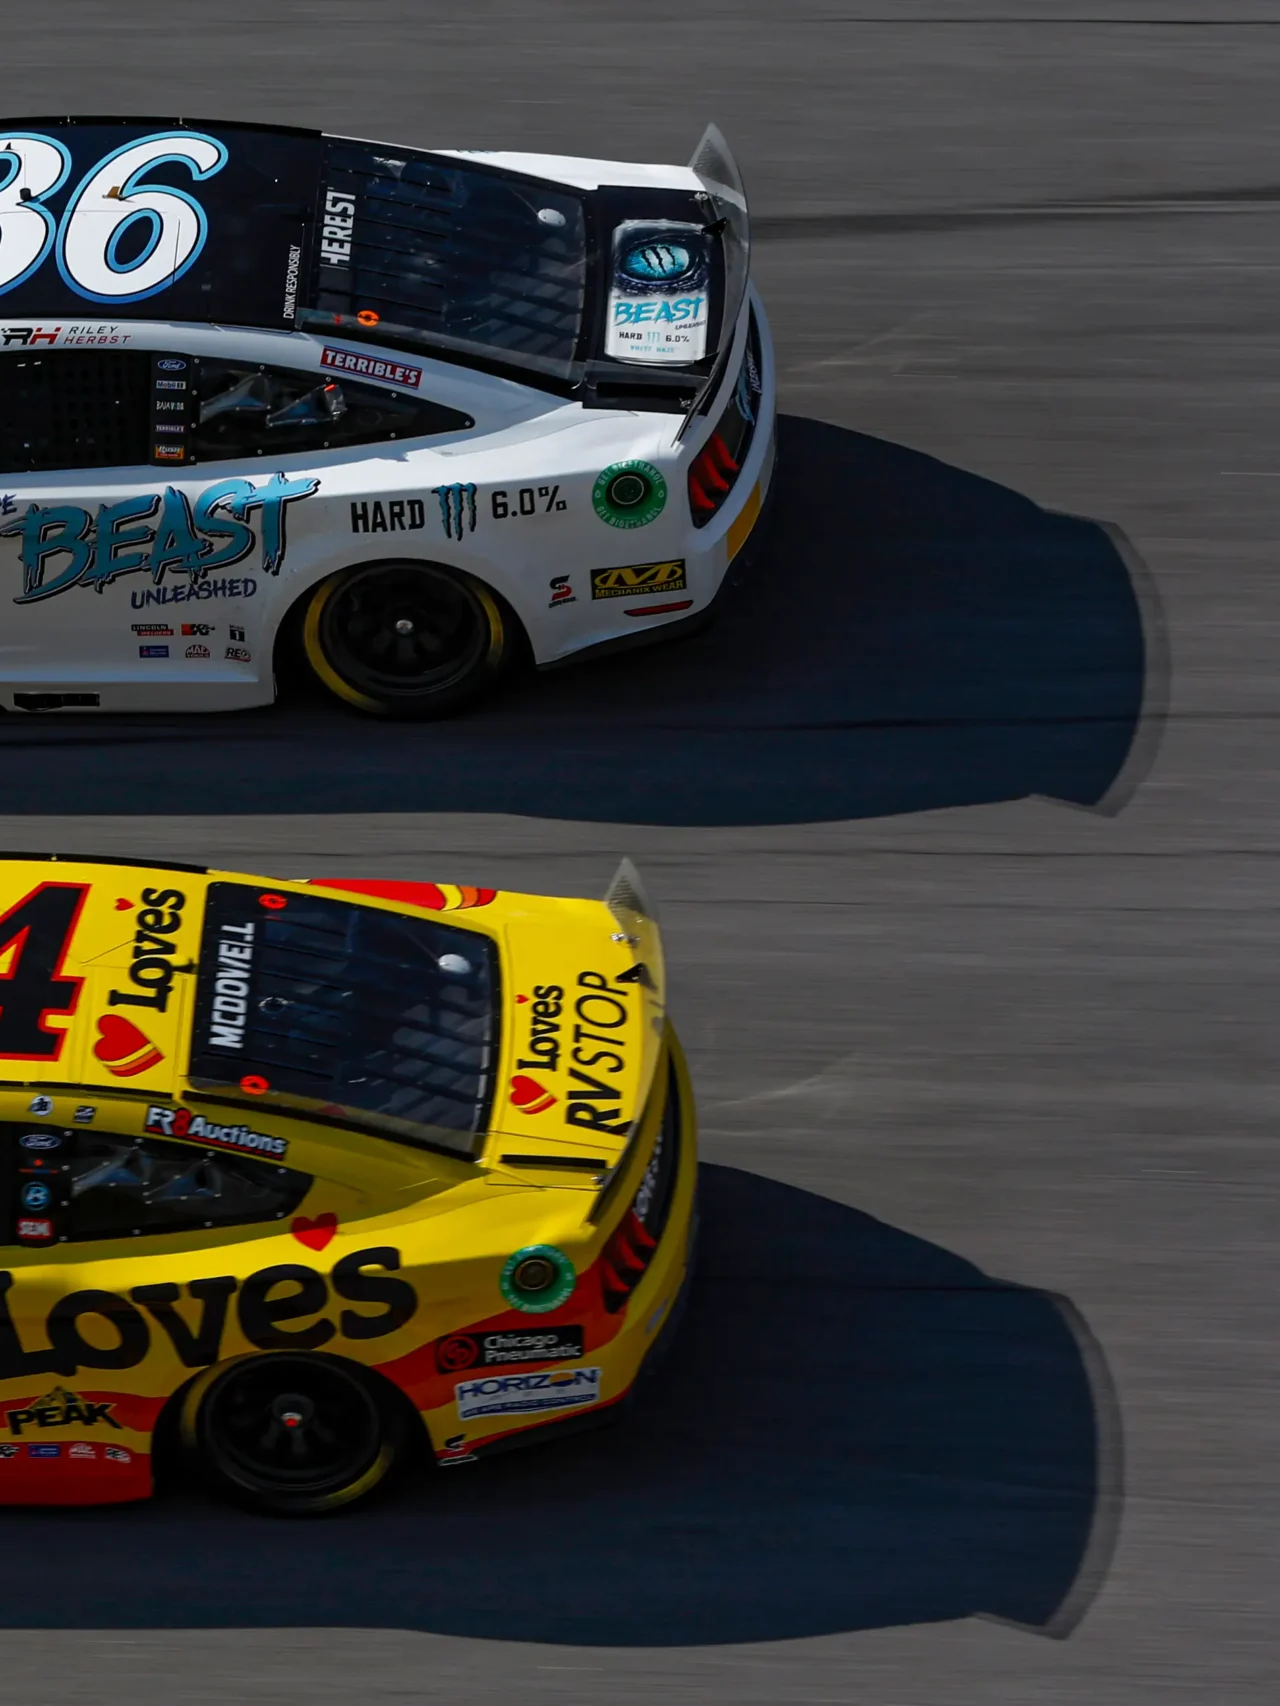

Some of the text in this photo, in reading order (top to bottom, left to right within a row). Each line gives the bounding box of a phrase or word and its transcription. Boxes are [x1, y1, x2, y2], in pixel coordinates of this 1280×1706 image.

[283, 245, 301, 319] DRINK RESPONSIBLY
[614, 297, 704, 326] BEAST
[63, 335, 132, 345] HERBST
[68, 325, 119, 335] RILEY
[619, 331, 690, 343] HARD 6.0%
[160, 360, 183, 370] Ford
[326, 350, 419, 385] TERRIBLE'S
[350, 485, 567, 533] HARD 6.0%
[130, 578, 257, 610] UNLEASHED
[595, 579, 684, 598] MECHANIX WEAR
[208, 922, 255, 1049] MCDOWELL
[484, 1333, 559, 1349] Chicago
[484, 1344, 582, 1363] Pneumatic
[7, 1402, 123, 1435] PEAK
